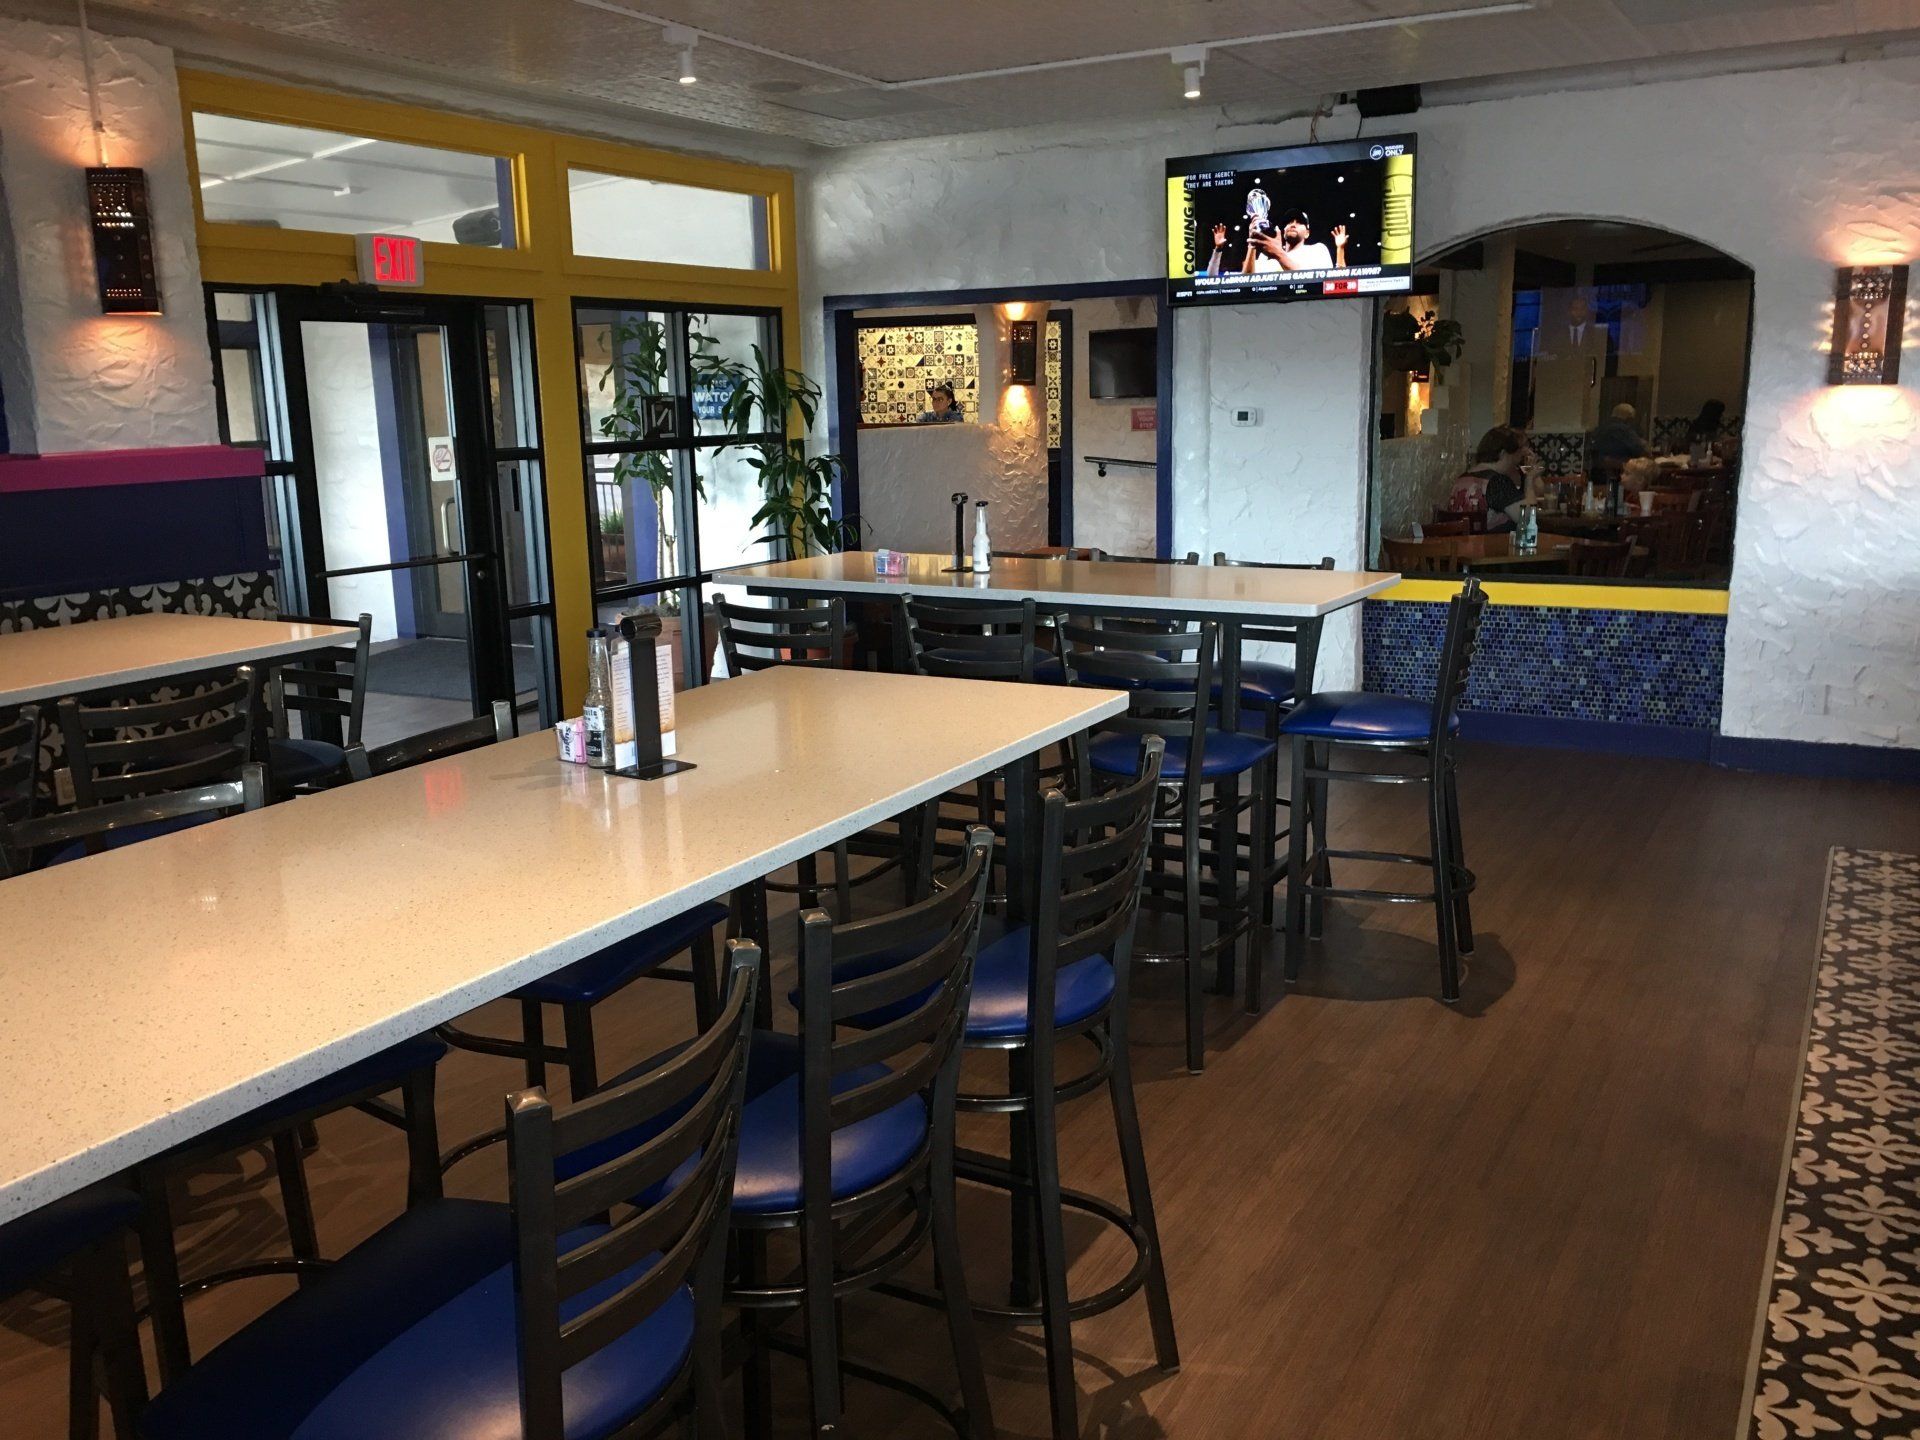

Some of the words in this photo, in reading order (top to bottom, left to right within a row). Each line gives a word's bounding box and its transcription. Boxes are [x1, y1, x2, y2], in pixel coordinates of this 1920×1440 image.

[1385, 149, 1403, 157] ONLY
[1214, 178, 1234, 186] TAKING
[1184, 207, 1195, 275] COMING
[373, 236, 417, 283] EXIT
[1195, 277, 1220, 286] WOULD
[1221, 275, 1250, 284] LeBRON
[1250, 273, 1279, 282] ADJUST
[1292, 271, 1315, 280] GAME
[1315, 270, 1325, 278] TO
[1350, 267, 1382, 276] KAWHI?
[1335, 282, 1347, 290] FOR
[698, 405, 715, 414] YOUR
[562, 725, 572, 757] Sugar
